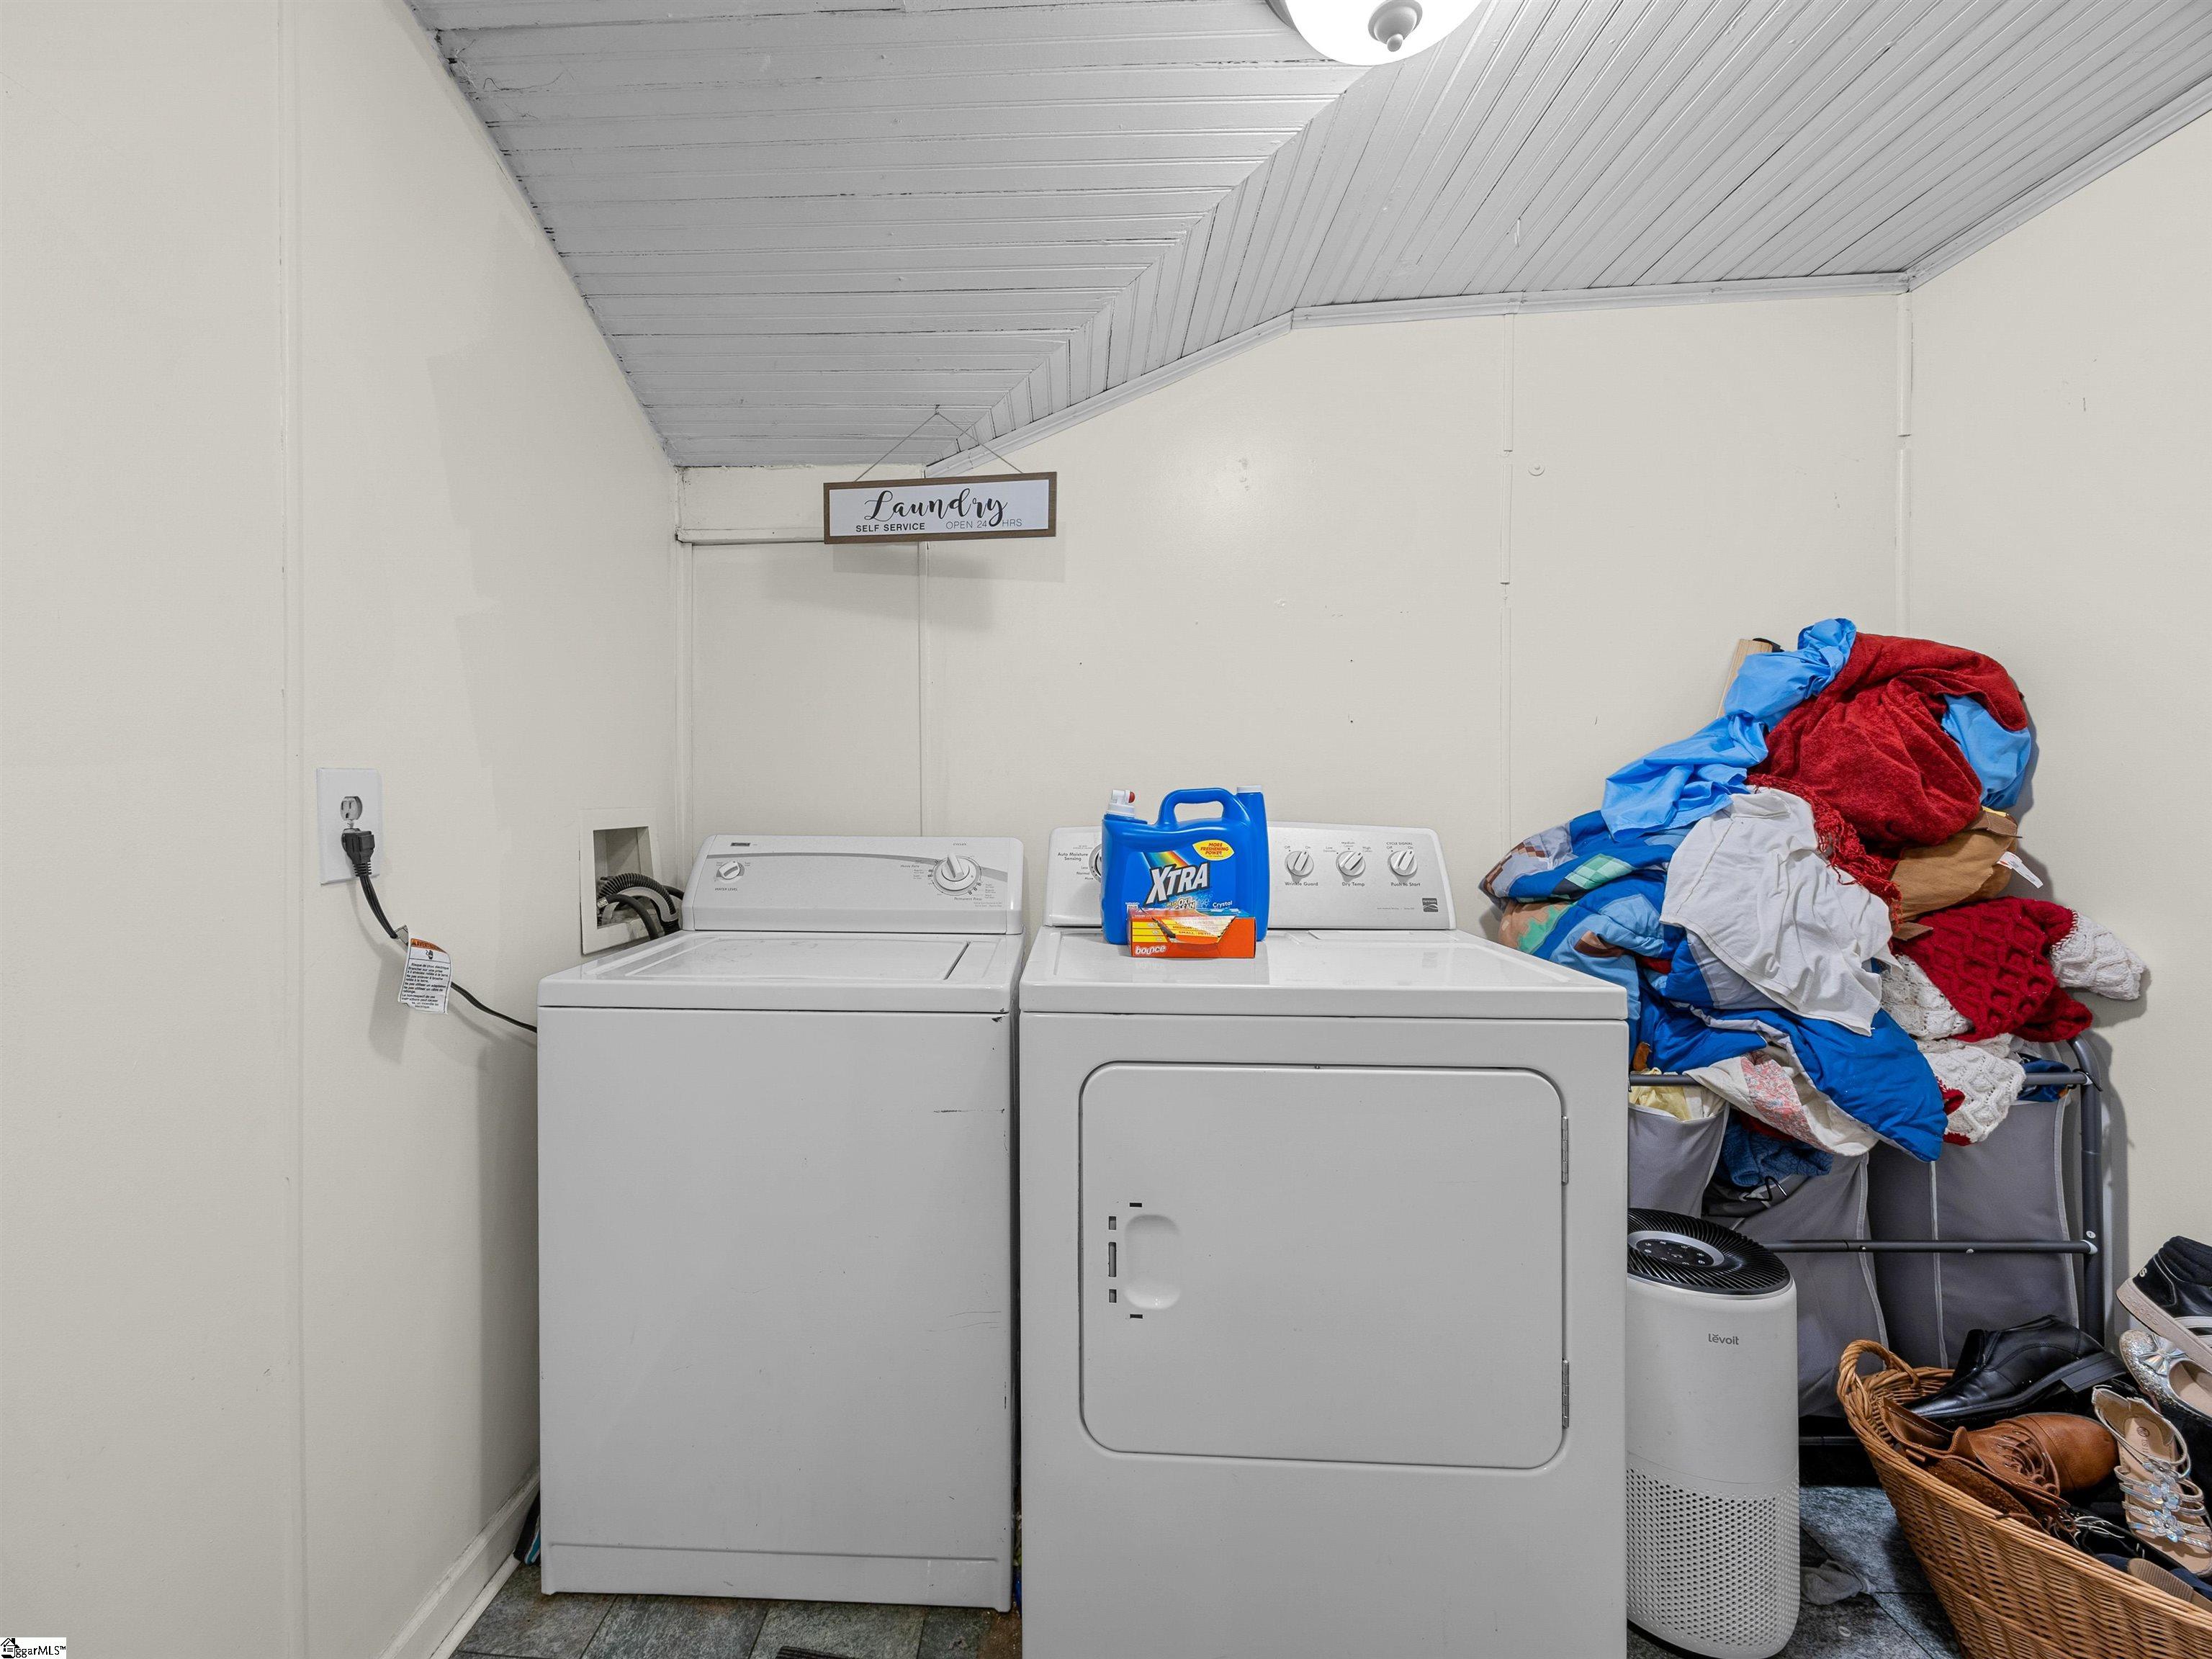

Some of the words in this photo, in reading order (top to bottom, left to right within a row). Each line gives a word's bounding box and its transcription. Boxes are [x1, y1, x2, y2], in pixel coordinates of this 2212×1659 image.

[864, 487, 1008, 527] Laundry
[884, 522, 925, 531] SERVICE
[945, 521, 973, 530] OPEN
[976, 520, 987, 529] 24
[1002, 518, 1022, 527] HRS
[1145, 863, 1209, 905] XTRA
